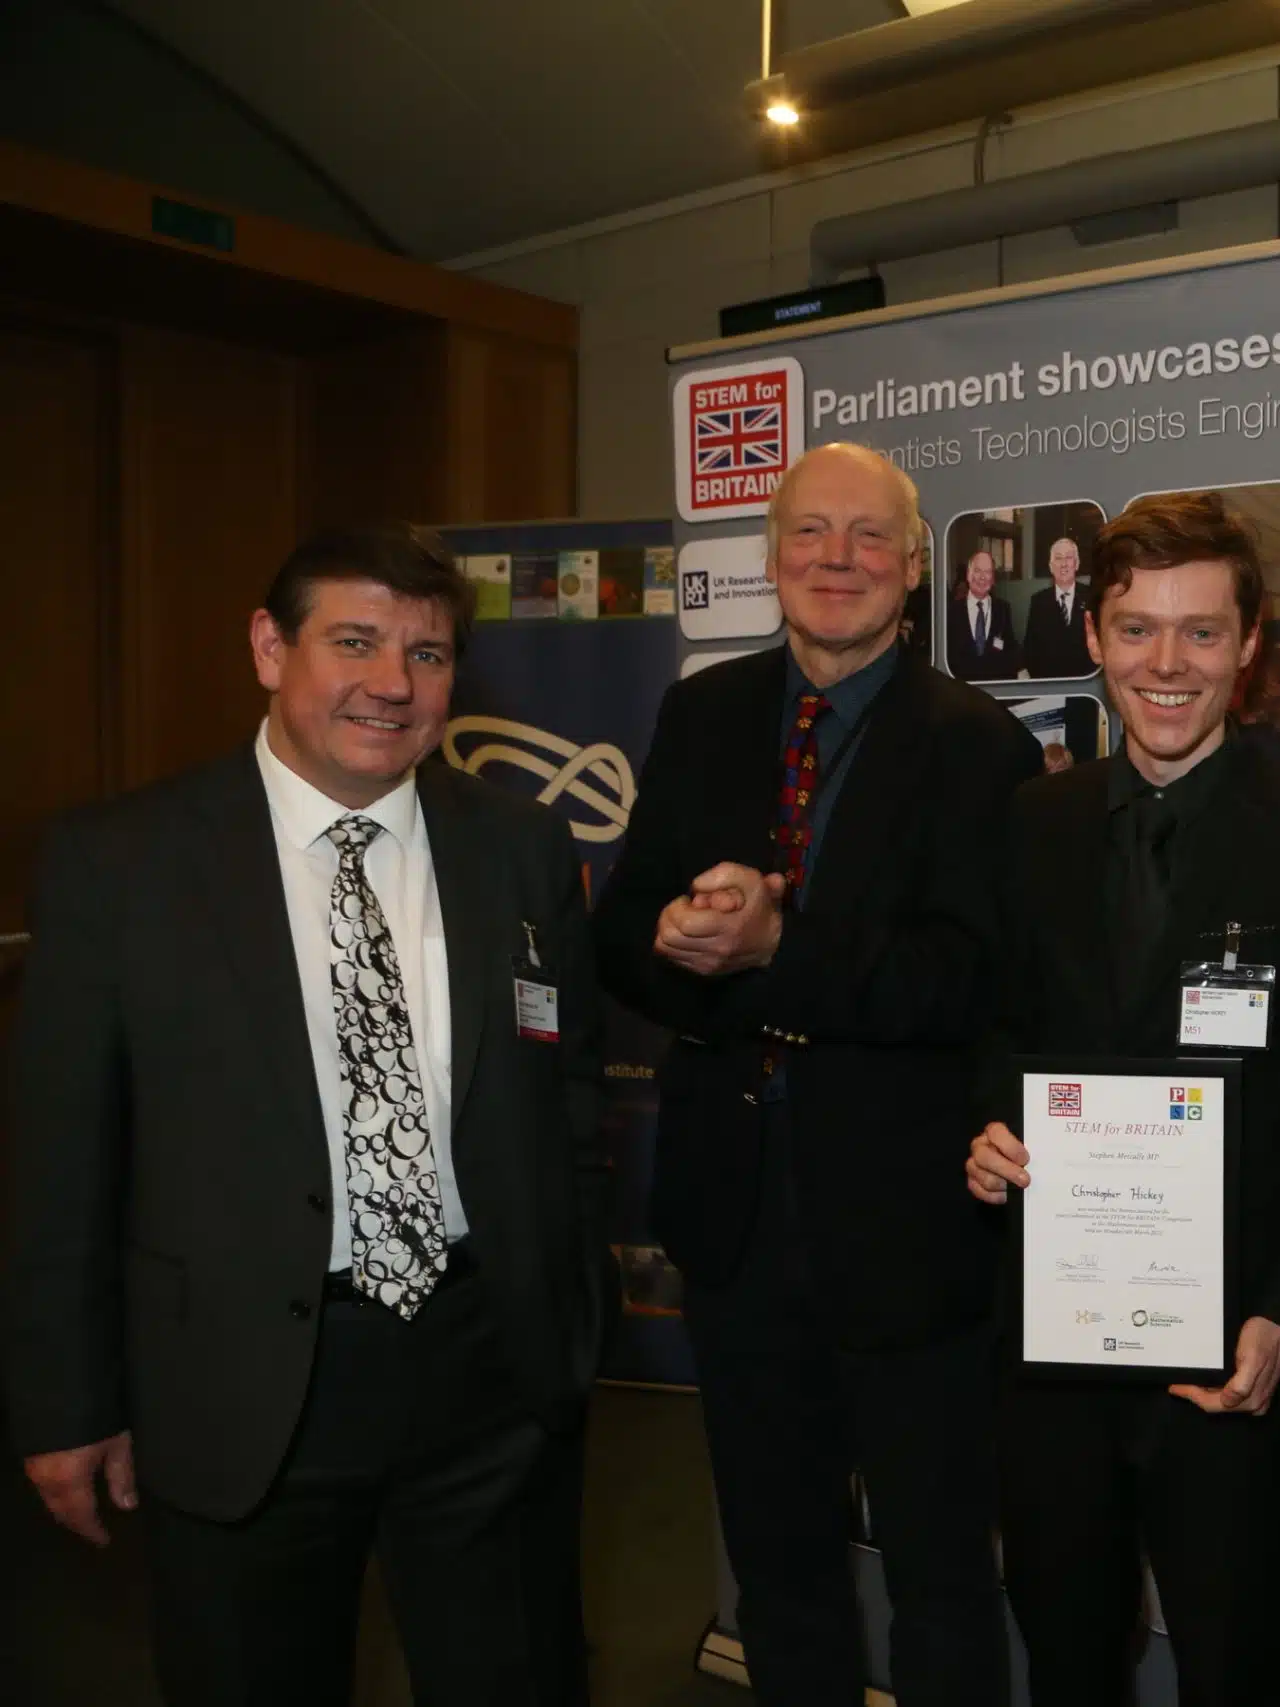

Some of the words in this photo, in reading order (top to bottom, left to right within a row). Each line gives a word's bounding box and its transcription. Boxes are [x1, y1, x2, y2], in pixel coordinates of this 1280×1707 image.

[695, 383, 748, 409] STEM
[754, 381, 782, 401] for
[812, 361, 1025, 429] Parliament
[970, 405, 1186, 461] Technologists
[695, 472, 783, 503] BRITAIN
[713, 576, 726, 587] UK
[714, 590, 731, 601] and
[1064, 1121, 1101, 1134] STEM
[1104, 1122, 1122, 1136] for
[1124, 1123, 1185, 1136] BRITAIN
[1071, 1184, 1122, 1203] Christopher
[1129, 1186, 1164, 1204] Hickey
